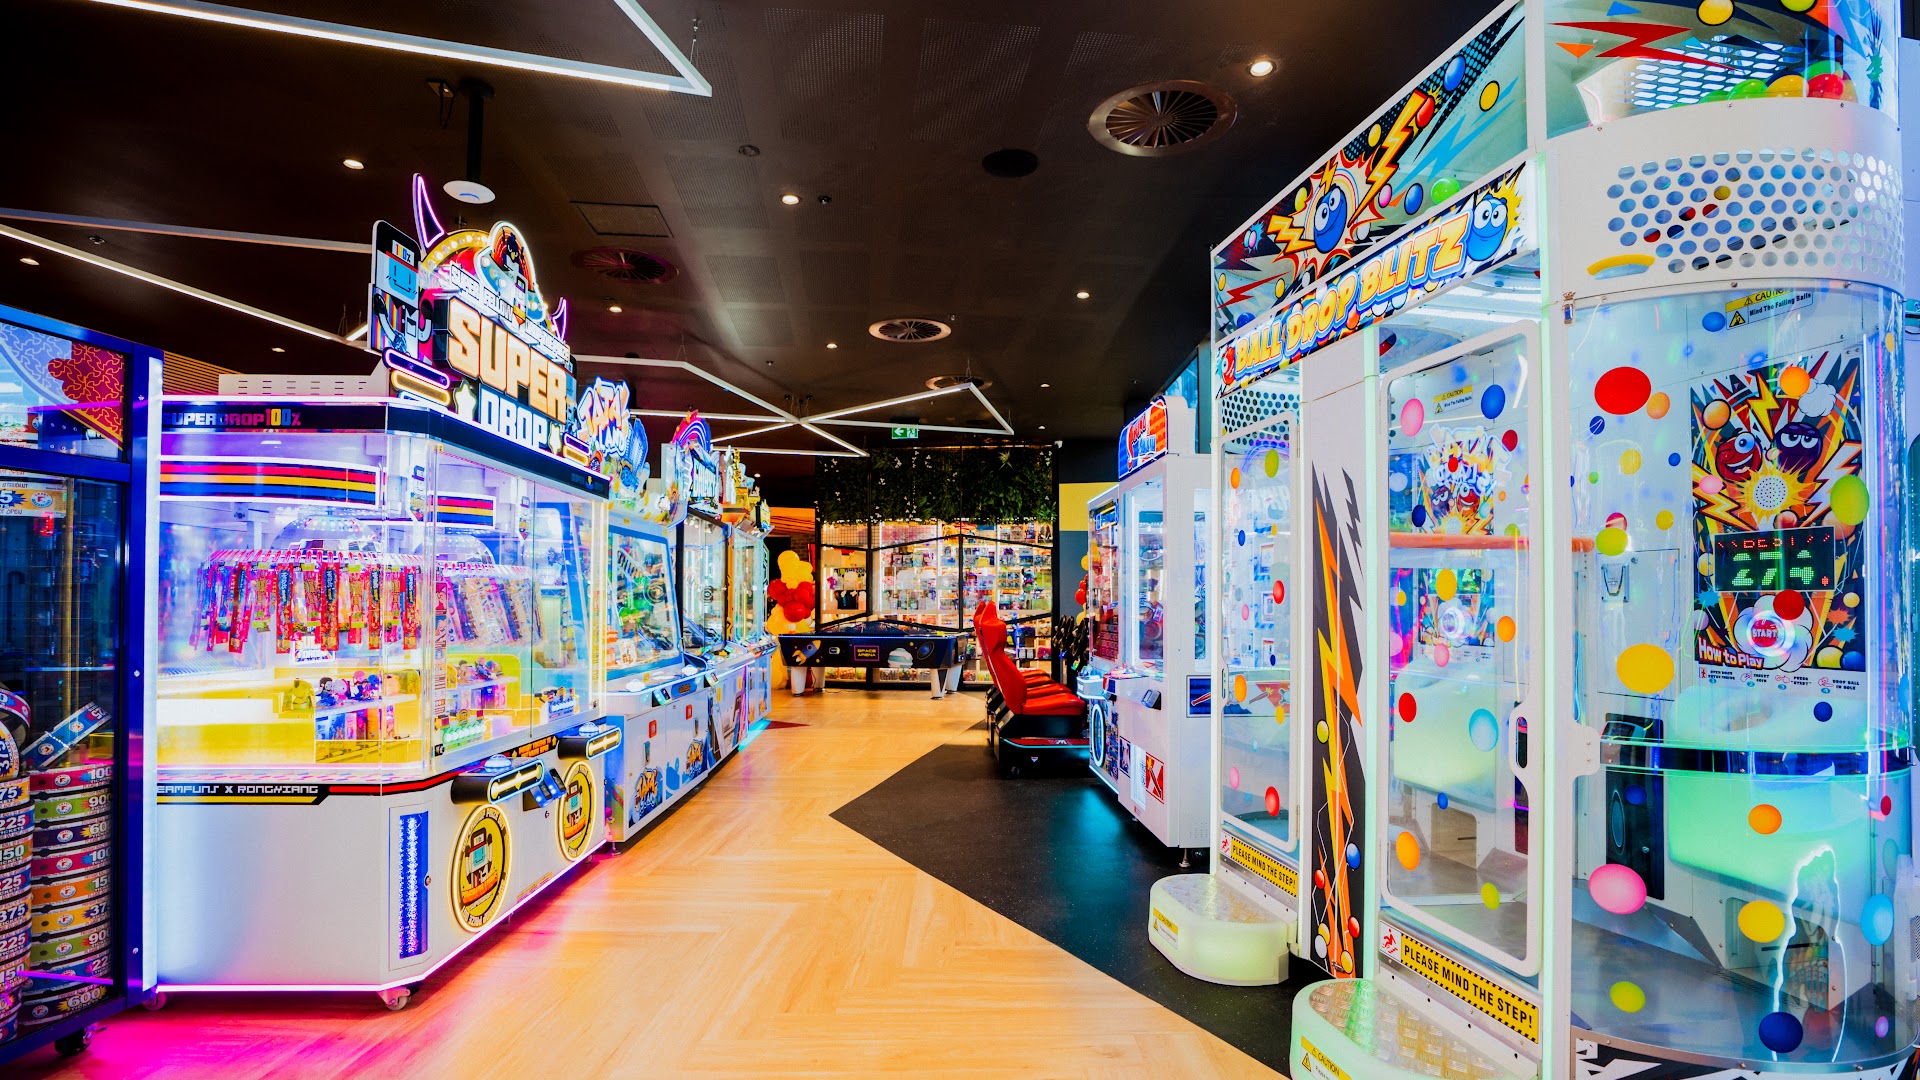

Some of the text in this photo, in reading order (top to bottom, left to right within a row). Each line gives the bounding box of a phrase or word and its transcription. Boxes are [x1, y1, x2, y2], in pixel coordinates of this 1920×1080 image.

[1235, 211, 1471, 374] BALL DROP BLITZ
[1749, 292, 1811, 316] Mind The Falling Balls
[448, 296, 567, 424] SUPER
[1446, 388, 1464, 399] CAUTION
[480, 386, 548, 450] DROP
[1752, 628, 1777, 638] START
[1698, 636, 1763, 669] How to Play
[237, 786, 318, 794] RONGXIANG
[1232, 845, 1296, 889] PLEASE MIND THE STEP!
[67, 987, 101, 1008] 600
[1404, 944, 1532, 1028] PLEASE MIND THE STEP!
[1317, 1052, 1340, 1077] CAUTION
